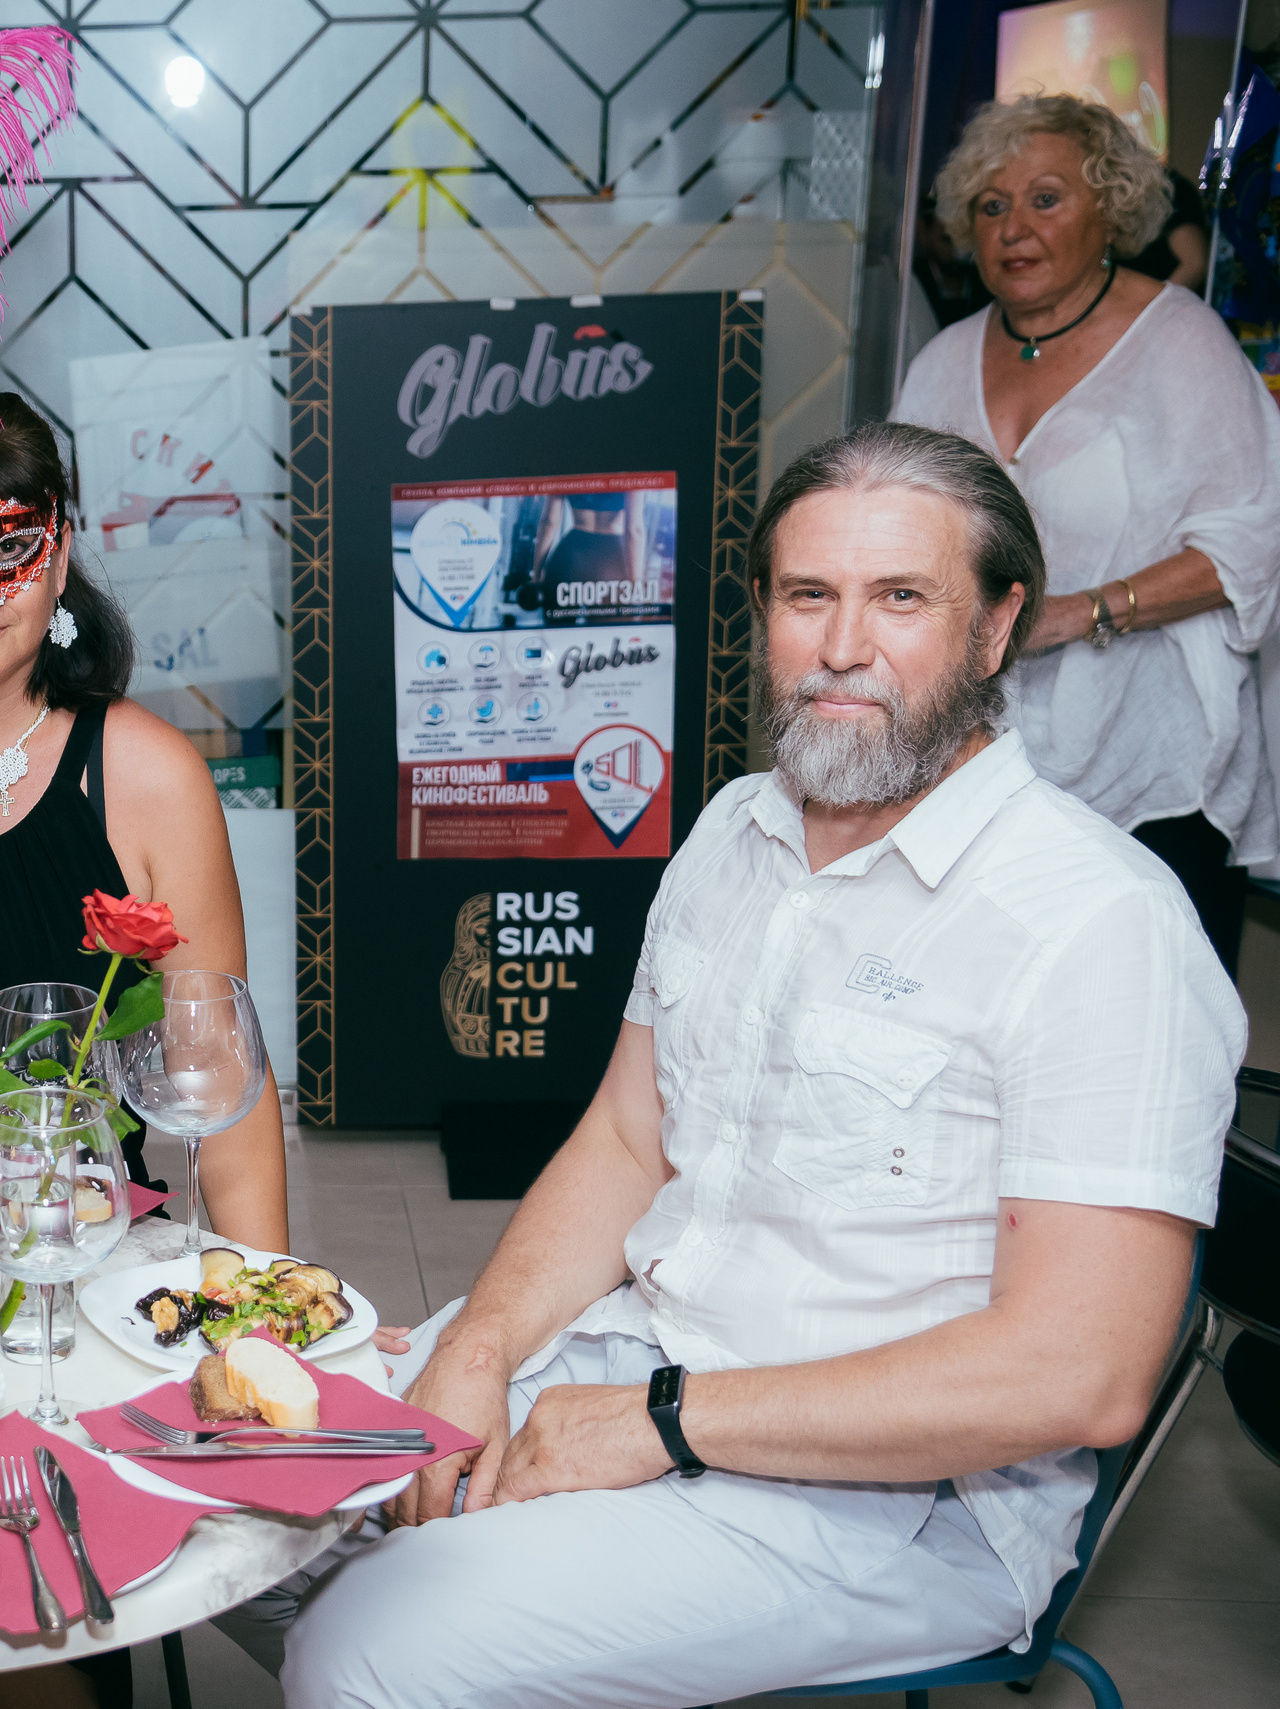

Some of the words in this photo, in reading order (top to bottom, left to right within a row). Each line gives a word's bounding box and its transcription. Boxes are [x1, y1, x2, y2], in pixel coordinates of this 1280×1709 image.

[556, 580, 661, 607] СПОРТЗАЛ
[412, 760, 502, 786] ЕЖЕГОДНЫЙ
[411, 783, 549, 806] КИНОФЕСТИВАЛЬ
[496, 891, 581, 921] RUS
[496, 926, 595, 956] SIAN
[496, 961, 578, 990] CUL
[496, 996, 550, 1025] TU
[495, 1029, 546, 1057] RE
